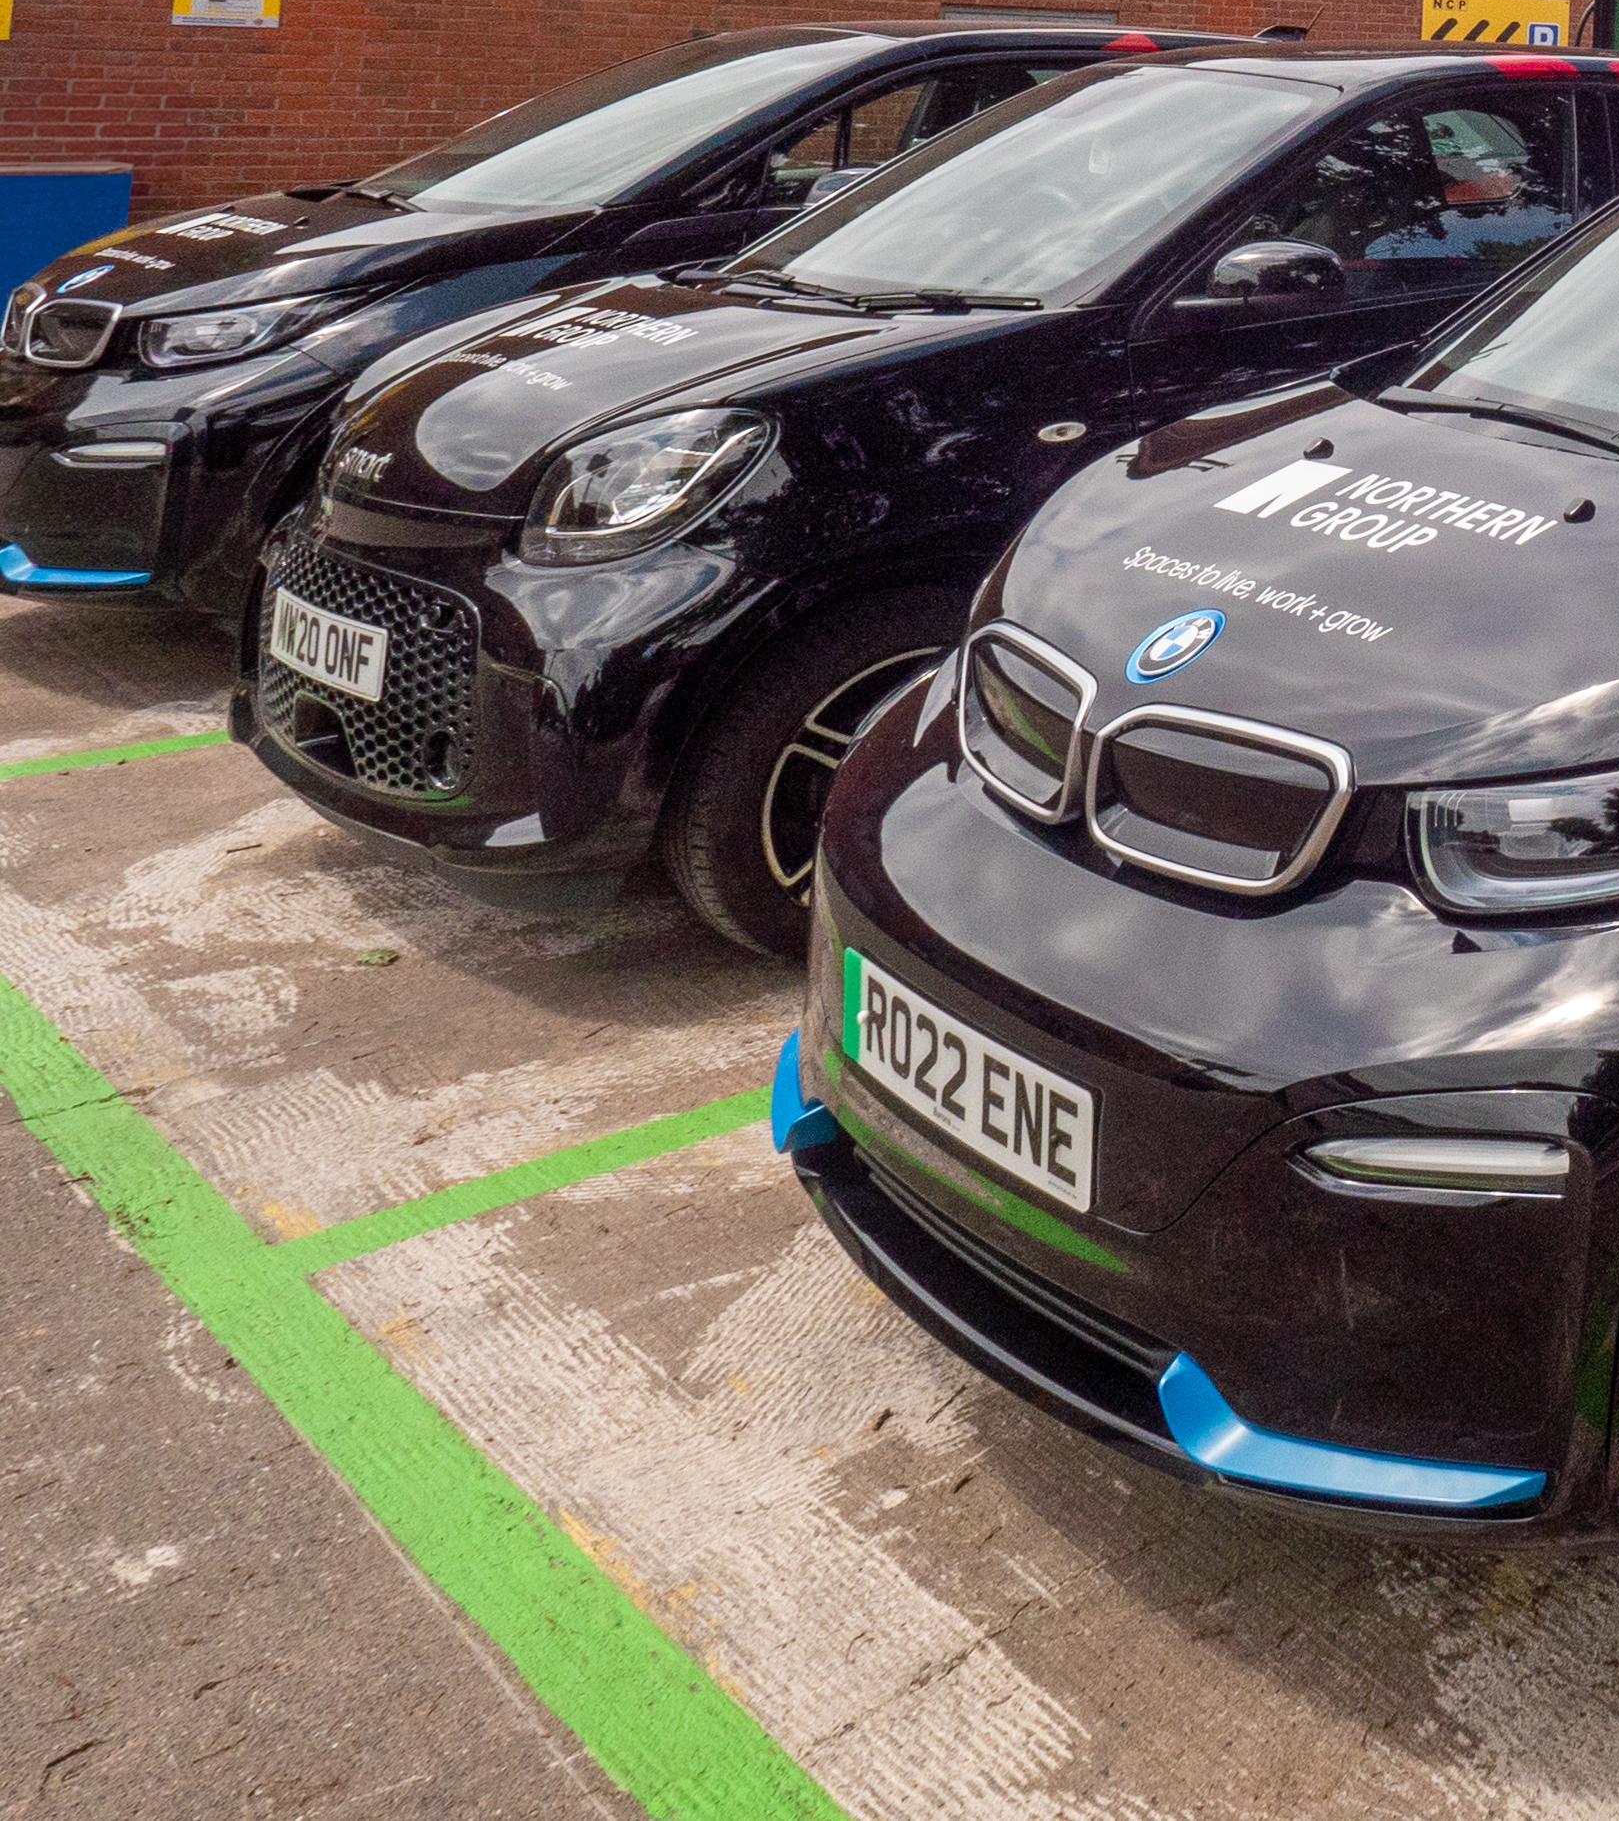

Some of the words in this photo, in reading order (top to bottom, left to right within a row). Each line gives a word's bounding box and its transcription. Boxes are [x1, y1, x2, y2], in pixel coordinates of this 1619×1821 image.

[532, 324, 620, 350] GROUP
[573, 308, 699, 347] NORTHERN
[1334, 473, 1558, 546] NORTHERN
[1290, 501, 1439, 554] GROUP
[1122, 545, 1200, 580] Spaces
[1191, 563, 1222, 586] to
[1212, 569, 1257, 600] live,
[1255, 585, 1317, 617] work
[1308, 605, 1329, 621] +
[1318, 609, 1394, 643] grow
[324, 624, 374, 685] ONF
[866, 974, 967, 1122] RO22
[981, 1052, 1079, 1188] ENE
